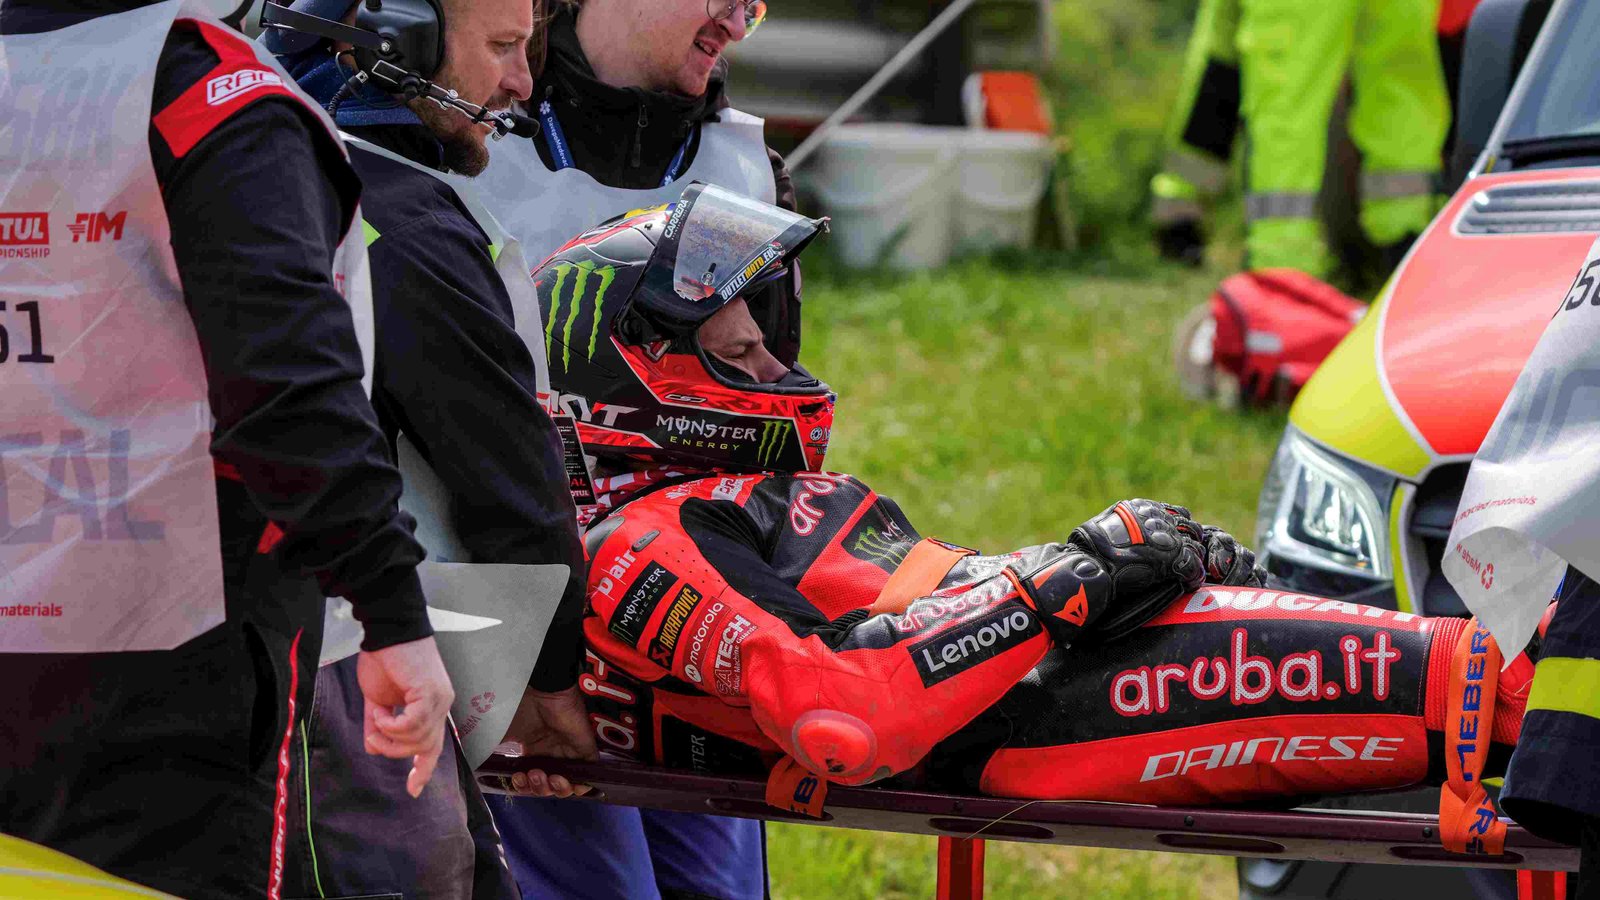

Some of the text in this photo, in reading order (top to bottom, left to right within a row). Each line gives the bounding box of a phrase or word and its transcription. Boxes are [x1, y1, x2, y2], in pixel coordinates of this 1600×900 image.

[0, 218, 44, 240] TUL
[66, 211, 128, 243] FIM
[664, 199, 689, 238] CARRERA
[670, 435, 740, 450] ENERGY
[689, 602, 724, 665] motorola
[922, 611, 1030, 673] Lenovo
[1111, 629, 1400, 715] aruba.it
[1140, 736, 1404, 783] DAINESE
